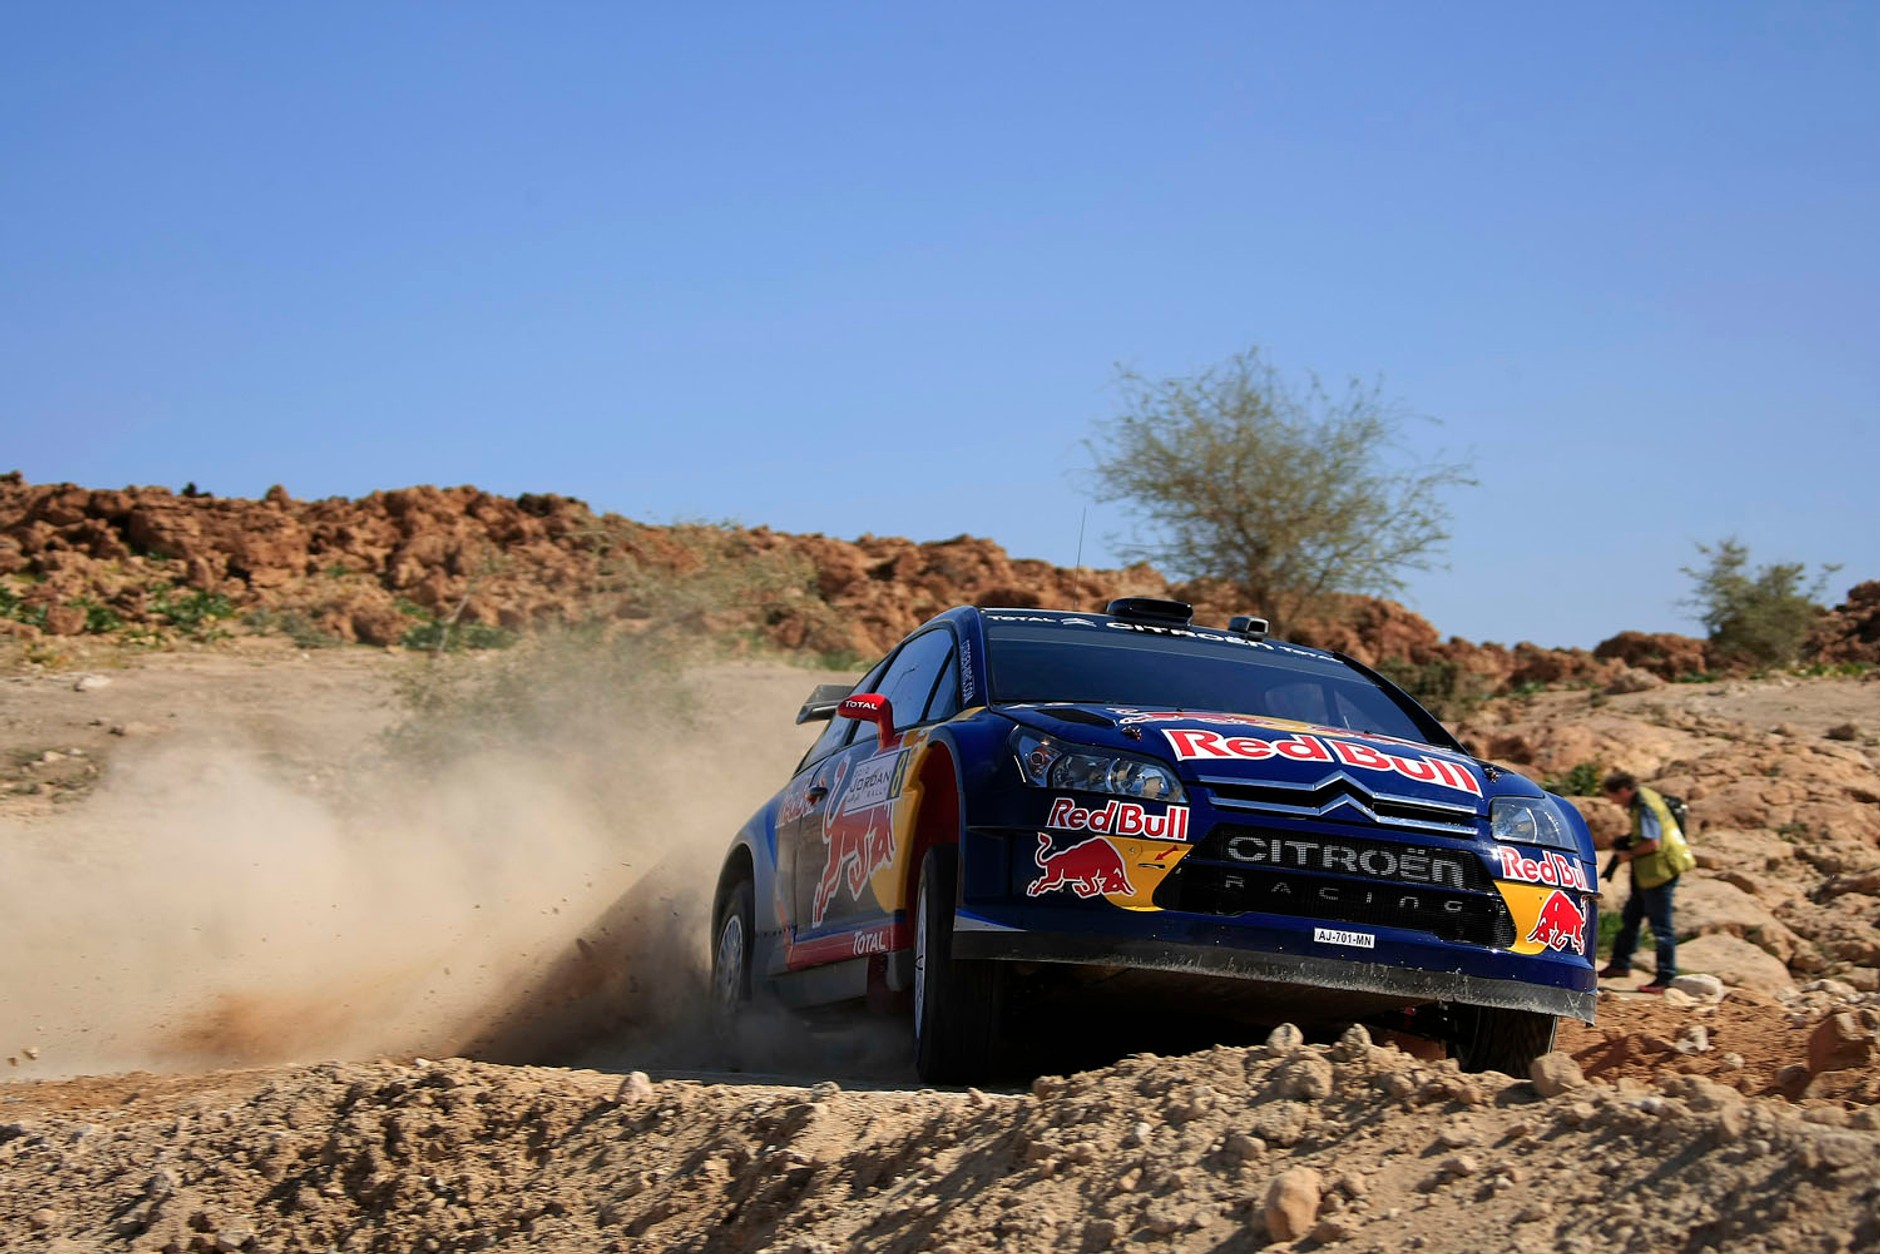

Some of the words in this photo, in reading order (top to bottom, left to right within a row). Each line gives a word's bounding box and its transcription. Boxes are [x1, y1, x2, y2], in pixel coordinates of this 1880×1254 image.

[845, 700, 878, 710] TOTAL
[1161, 728, 1335, 763] Red
[1324, 738, 1484, 799] Bull
[850, 770, 891, 793] JORDAN
[1045, 797, 1120, 834] Red
[1116, 802, 1191, 842] Bull
[1497, 845, 1559, 887] Red
[853, 930, 889, 956] TOTAL
[1318, 930, 1372, 946] AJ-701-MN
